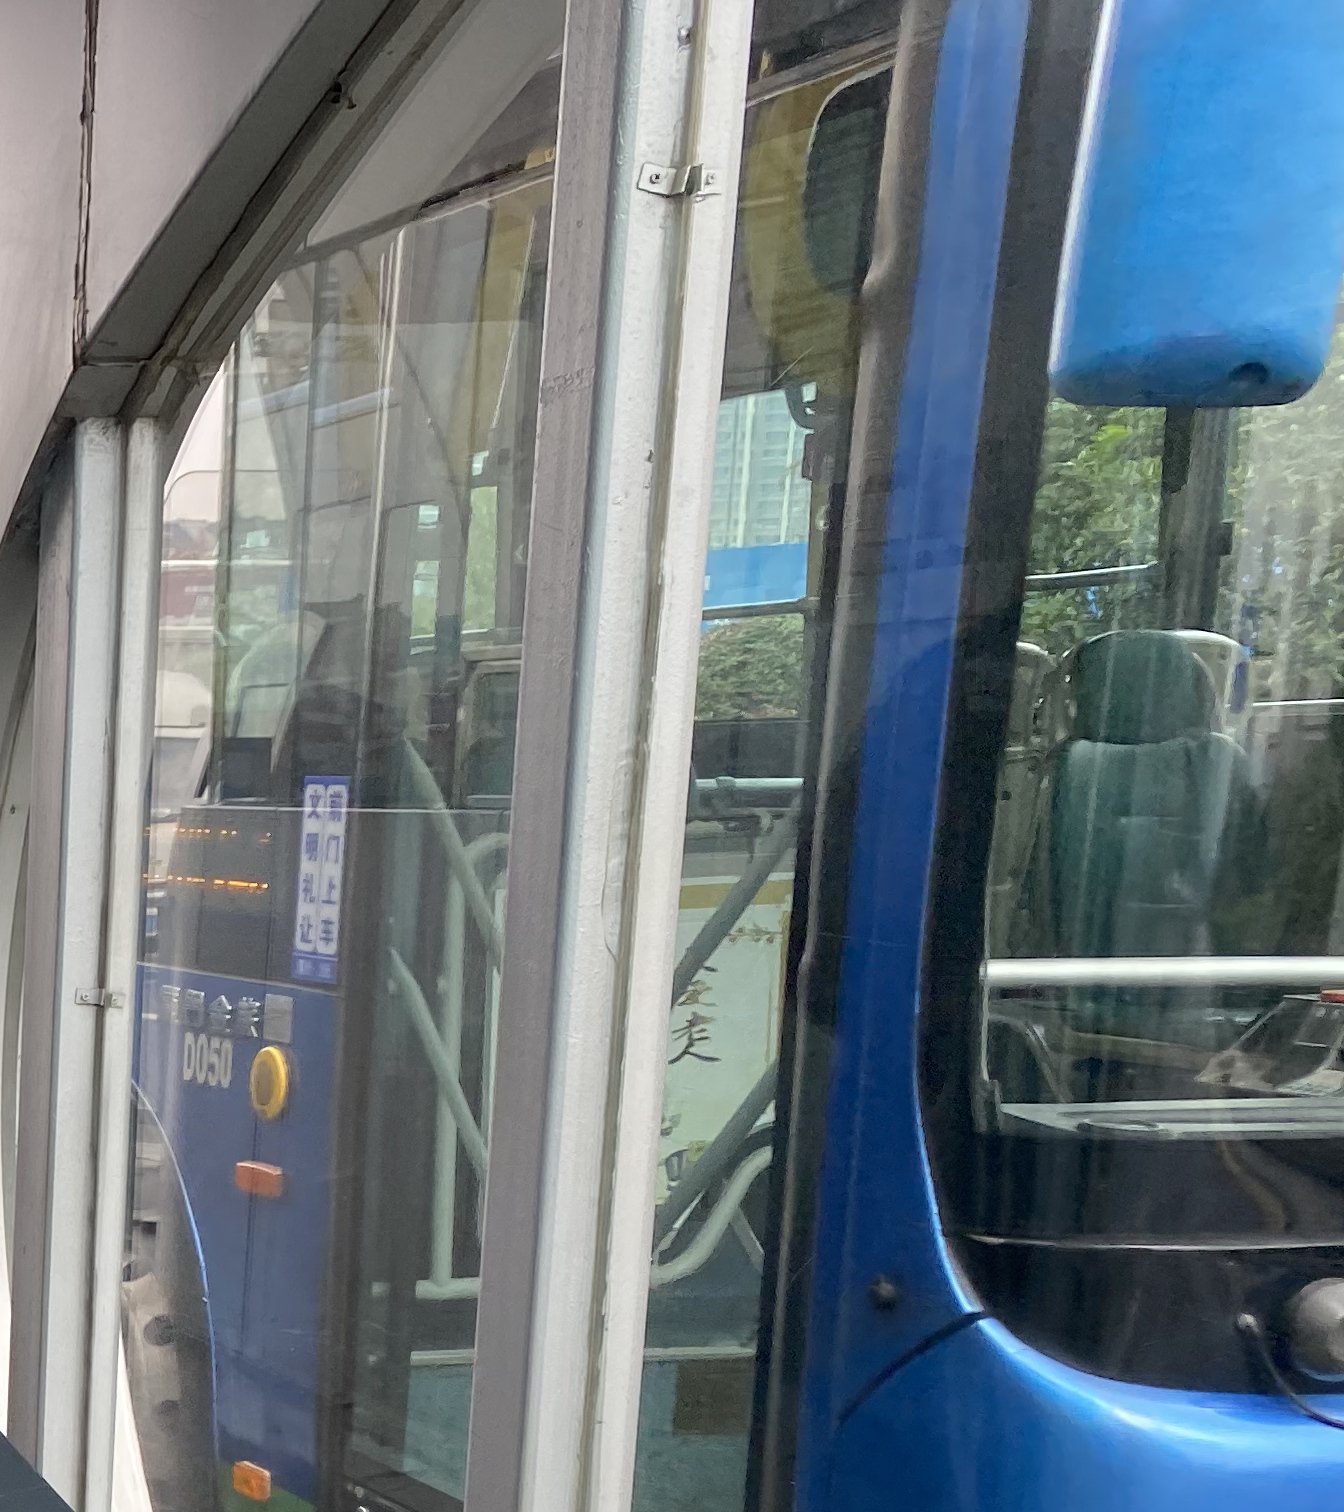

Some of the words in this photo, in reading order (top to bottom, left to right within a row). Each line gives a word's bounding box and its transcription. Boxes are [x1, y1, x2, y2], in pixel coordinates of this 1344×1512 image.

[319, 789, 344, 947] 前门上车
[183, 1031, 233, 1089] D050
